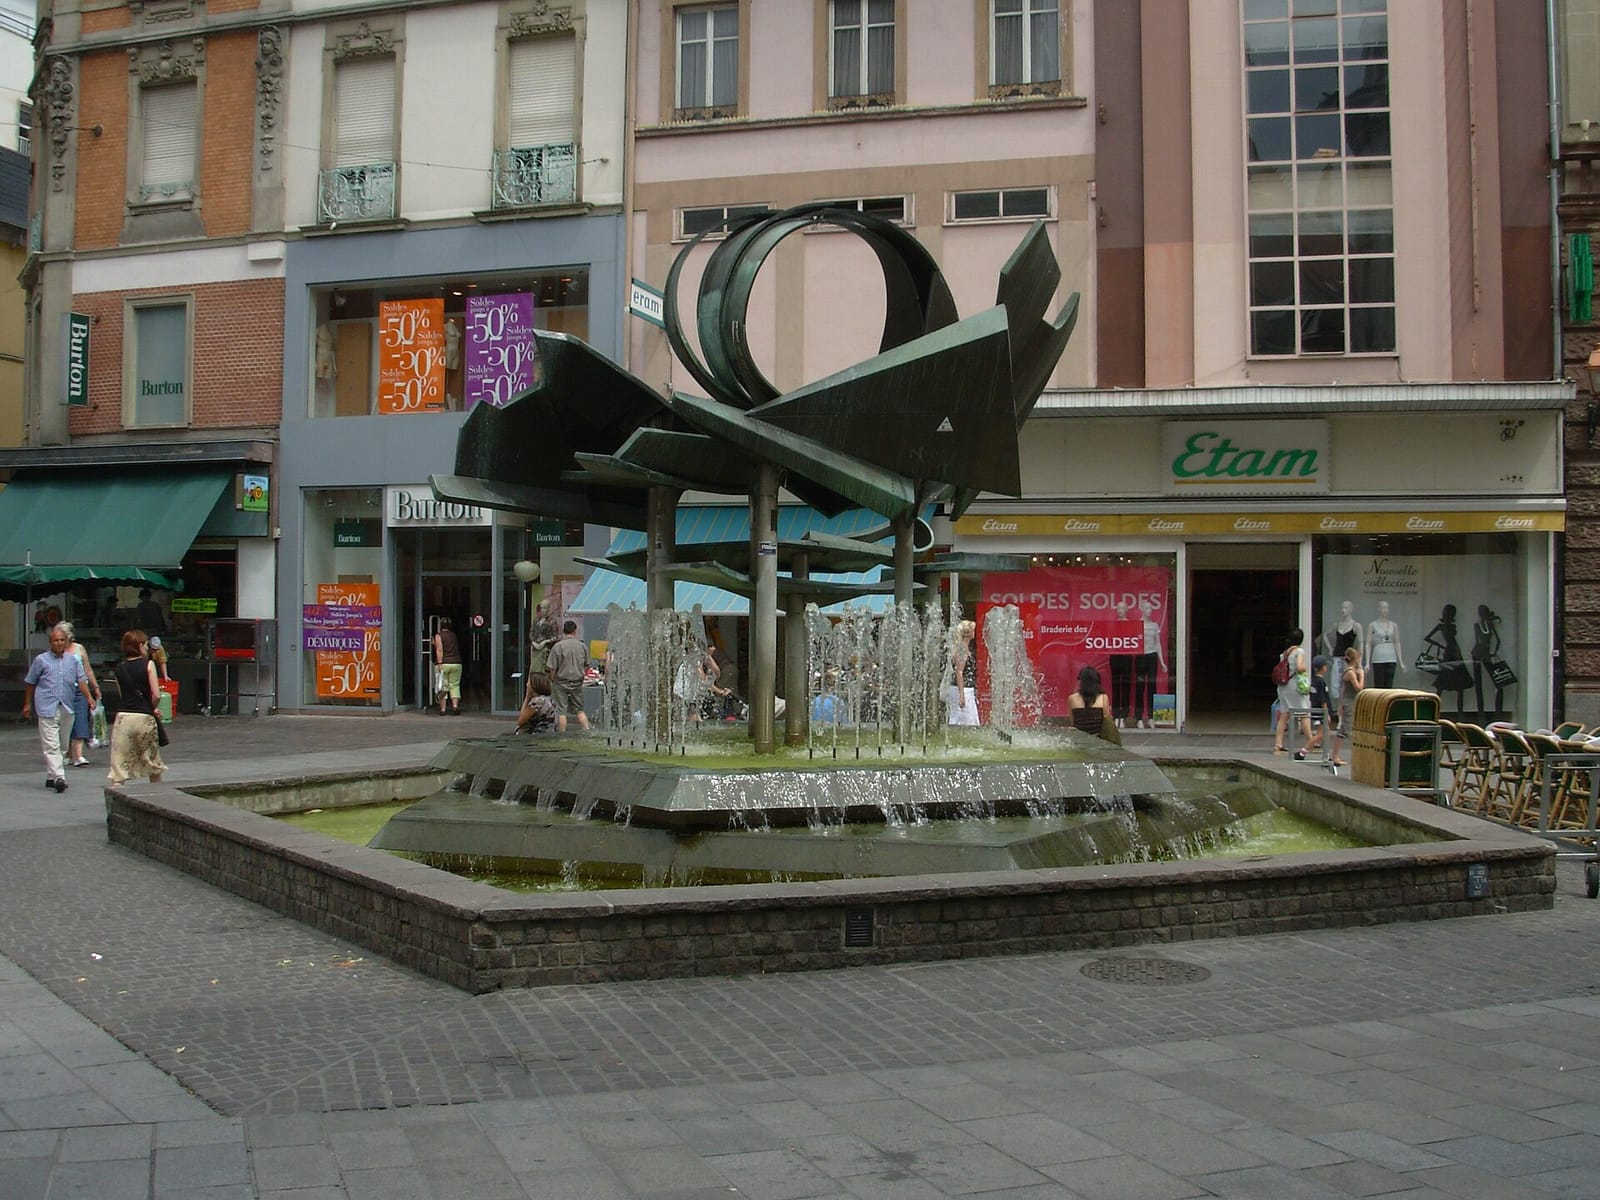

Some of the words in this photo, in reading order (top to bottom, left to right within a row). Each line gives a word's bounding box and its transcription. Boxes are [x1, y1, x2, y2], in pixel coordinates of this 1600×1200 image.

[633, 291, 659, 313] eram
[70, 322, 88, 396] Burton
[142, 379, 183, 396] Burton
[1172, 432, 1319, 478] Etam
[982, 518, 1017, 532] Etam
[1064, 518, 1100, 532] Etam
[1148, 518, 1184, 531] Etam
[1233, 517, 1270, 530] Etam
[1319, 516, 1357, 530] Etam
[1406, 515, 1445, 530] Etam
[1495, 514, 1535, 528] Etam
[536, 532, 561, 542] Burton
[1080, 592, 1162, 610] SOLDES
[1041, 625, 1073, 633] Braderie
[1074, 625, 1088, 633] des
[1085, 637, 1140, 649] SOLDES
